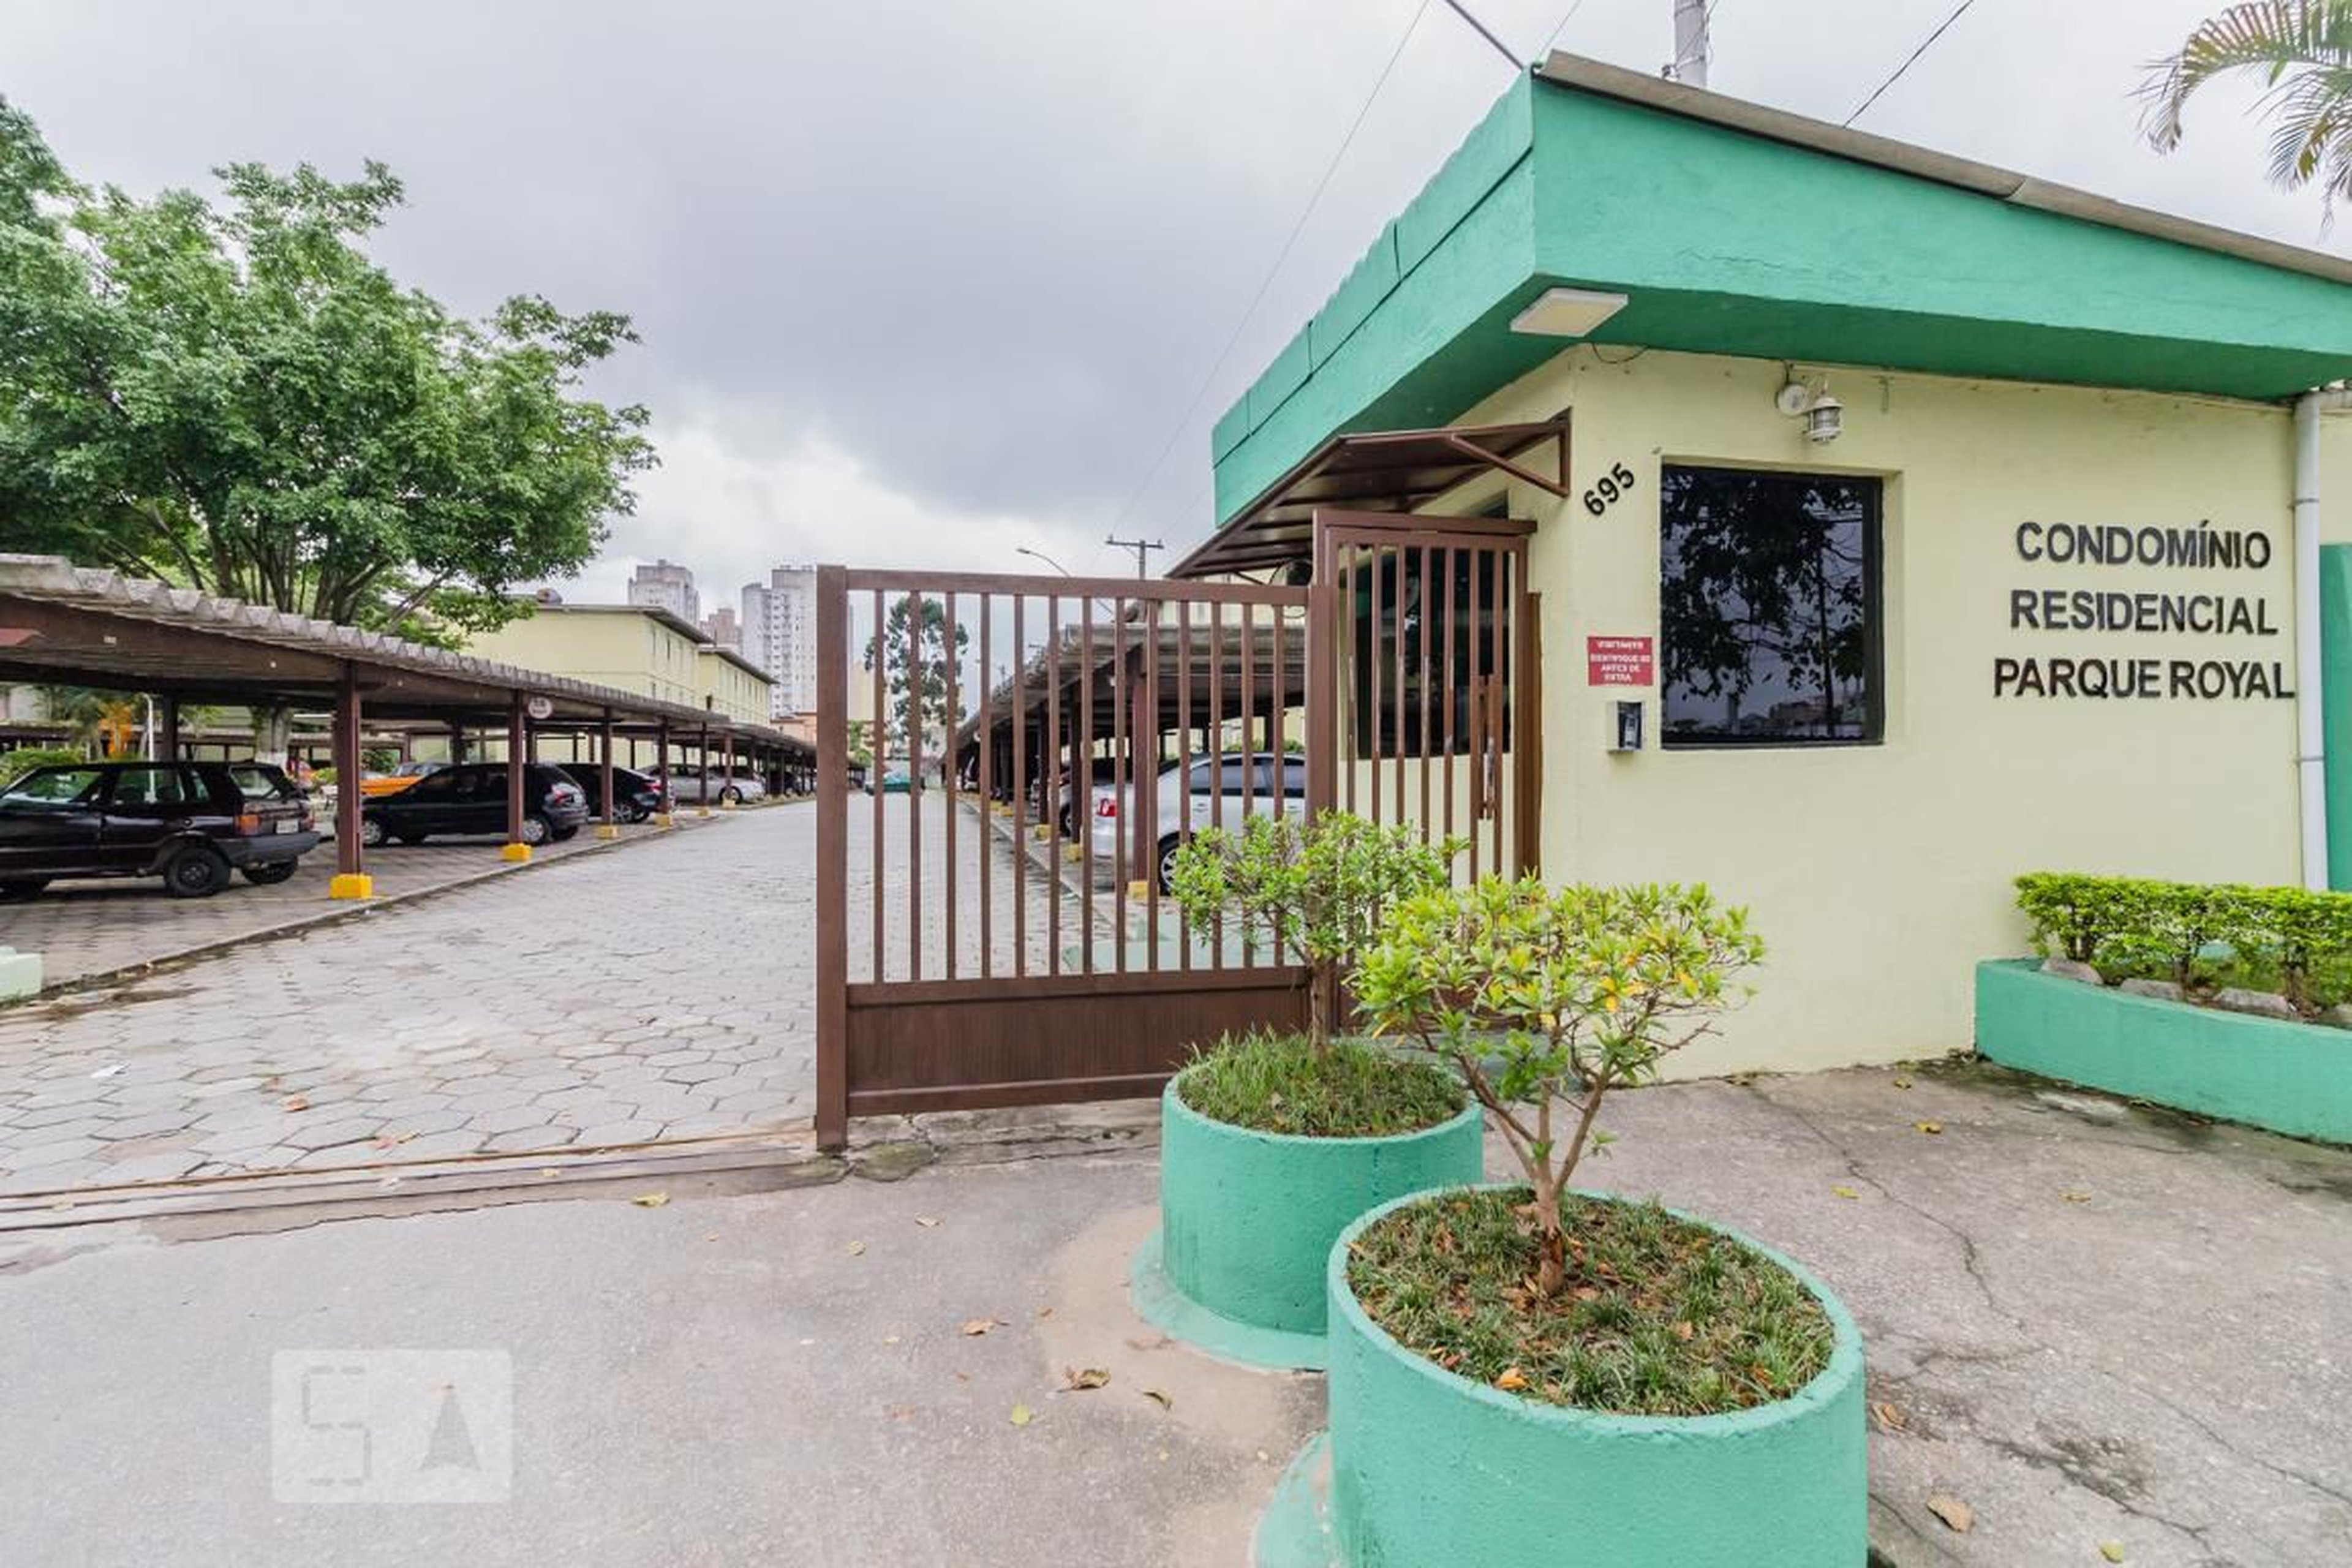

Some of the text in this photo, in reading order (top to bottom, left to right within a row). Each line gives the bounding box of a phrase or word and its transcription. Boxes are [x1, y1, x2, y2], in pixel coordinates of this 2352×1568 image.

[1583, 462, 1634, 516] 695
[2016, 519, 2271, 569] CONDOMÍNIO
[2010, 589, 2278, 635] RESIDENCIAL
[1993, 657, 2296, 699] PARQUE ROYAL
